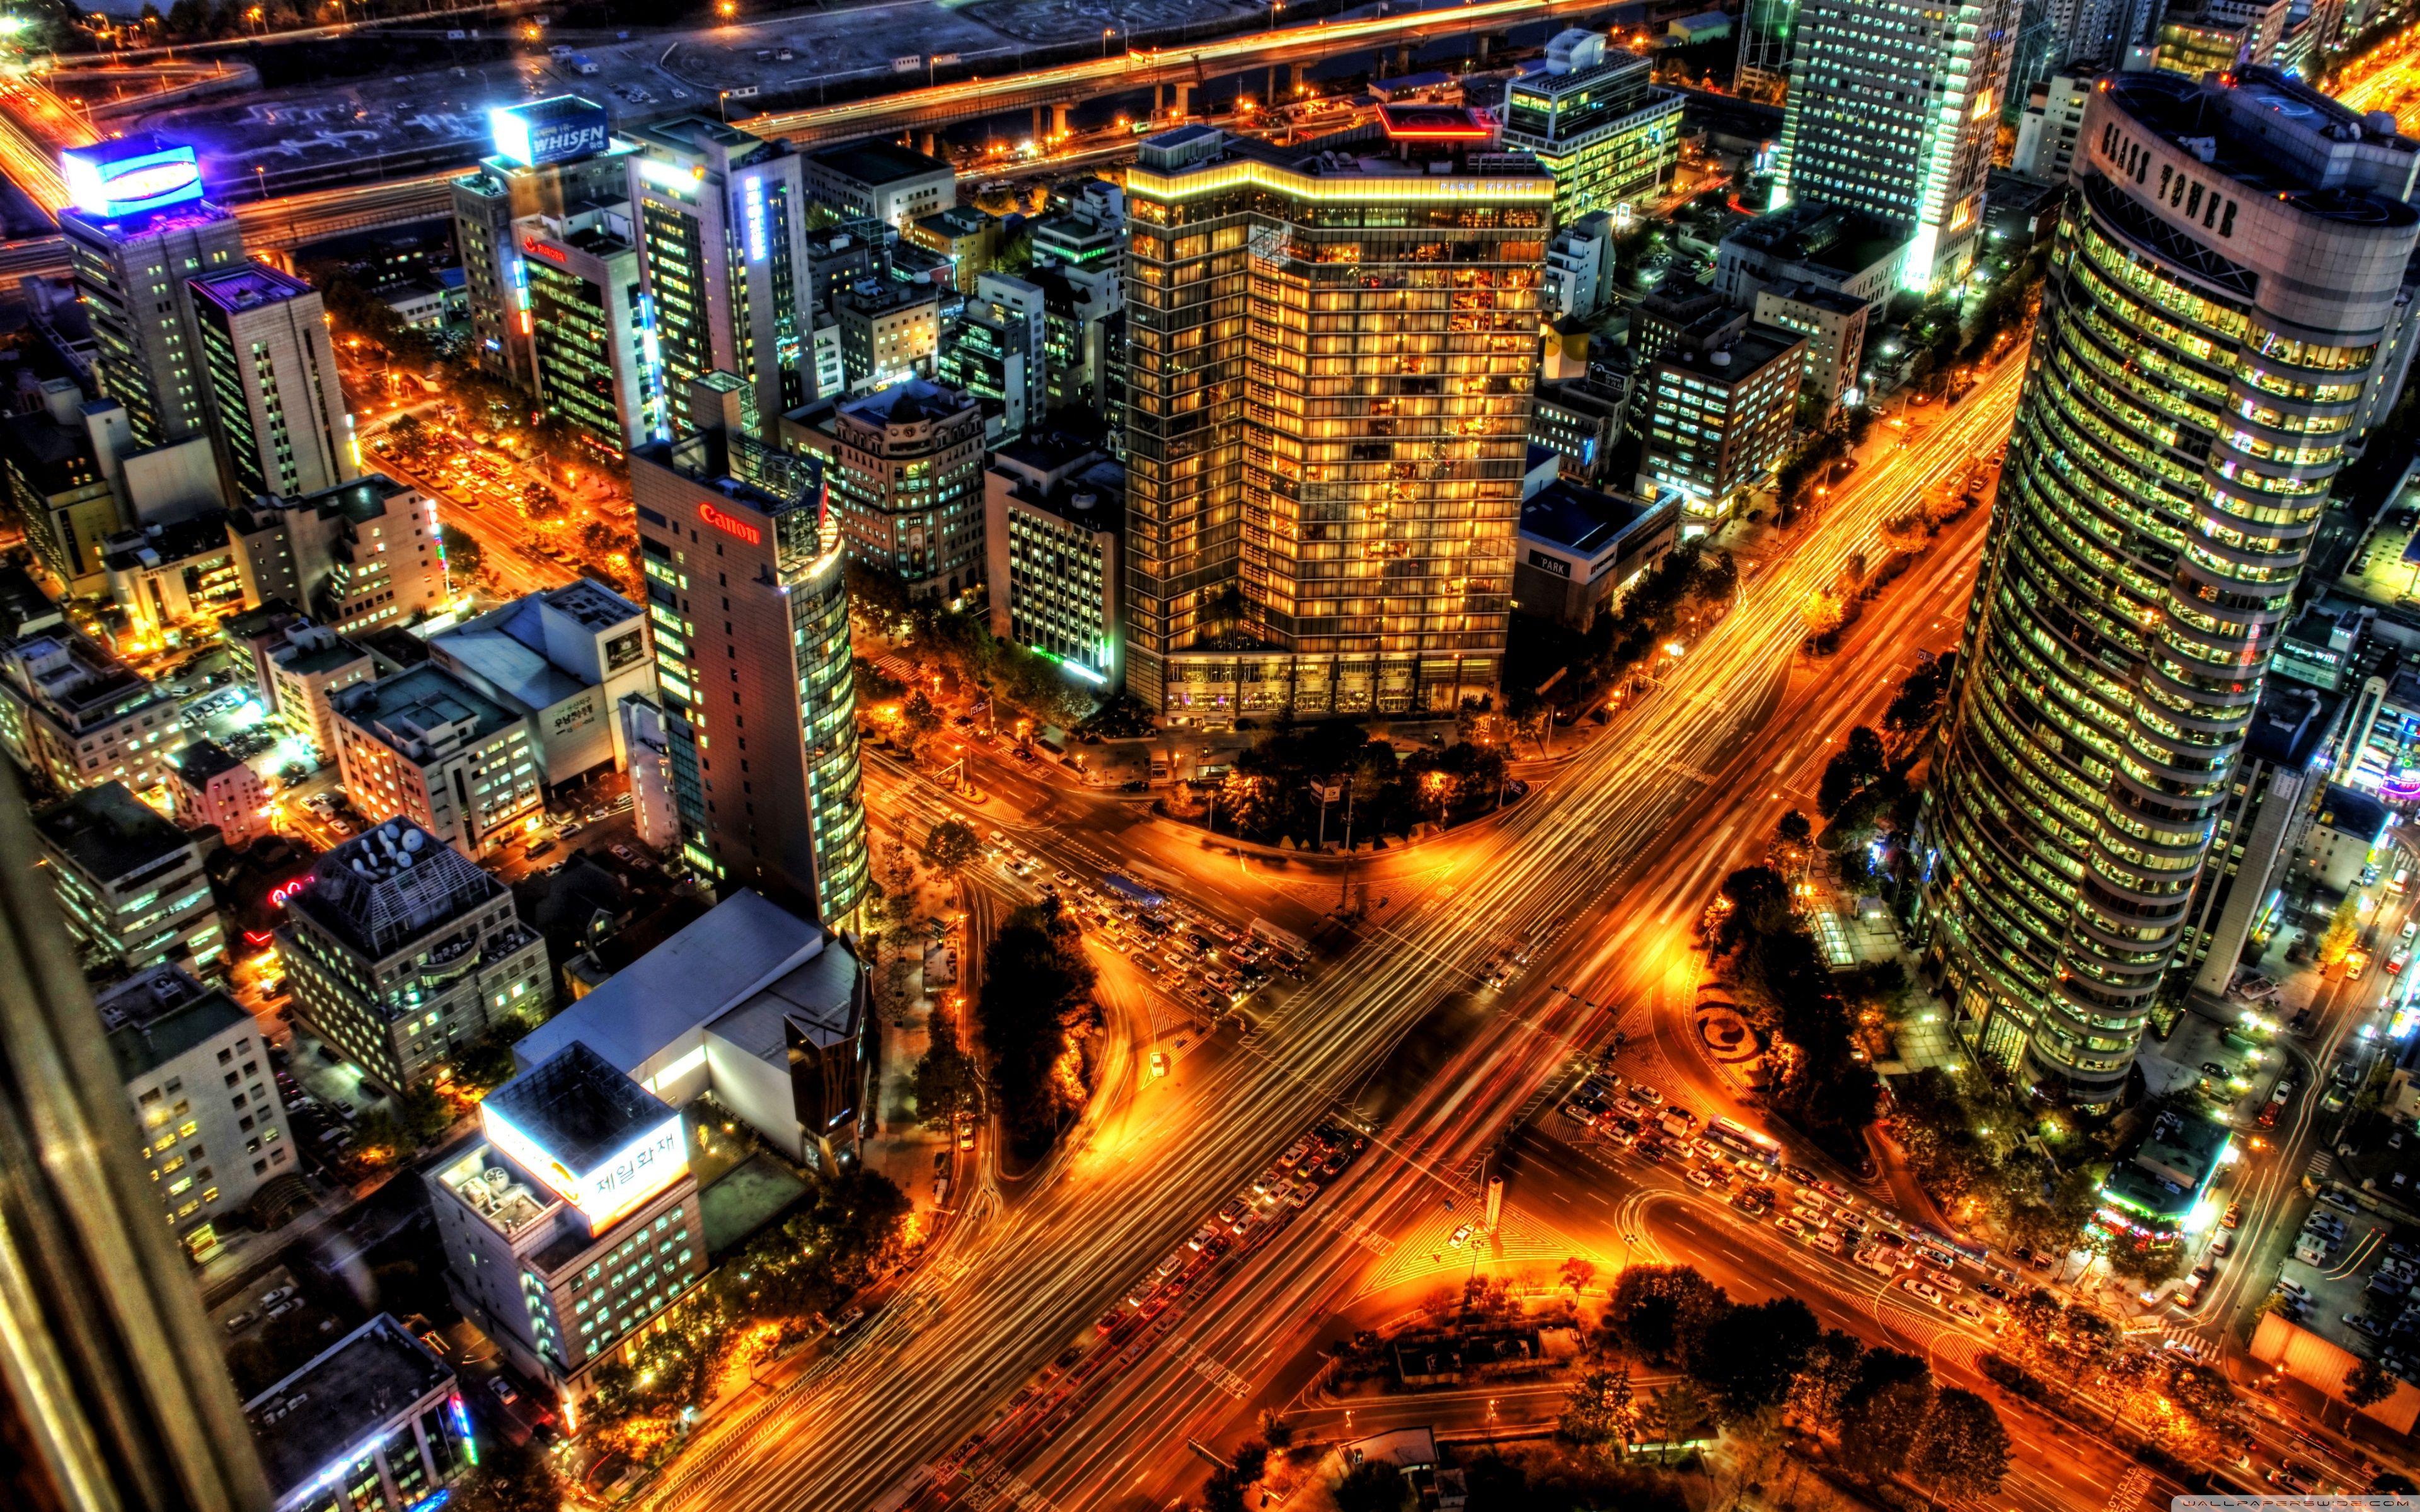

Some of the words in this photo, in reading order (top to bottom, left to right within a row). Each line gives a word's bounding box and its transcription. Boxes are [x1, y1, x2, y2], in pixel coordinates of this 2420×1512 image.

[534, 125, 604, 153] WHISEN
[1440, 183, 1475, 192] PARK
[1486, 183, 1532, 192] HYATT
[2100, 122, 2151, 185] GLASS
[2158, 163, 2237, 238] TOWER
[537, 244, 565, 263] AURORA
[700, 503, 759, 545] Canon
[596, 1133, 673, 1194] 제일화재
